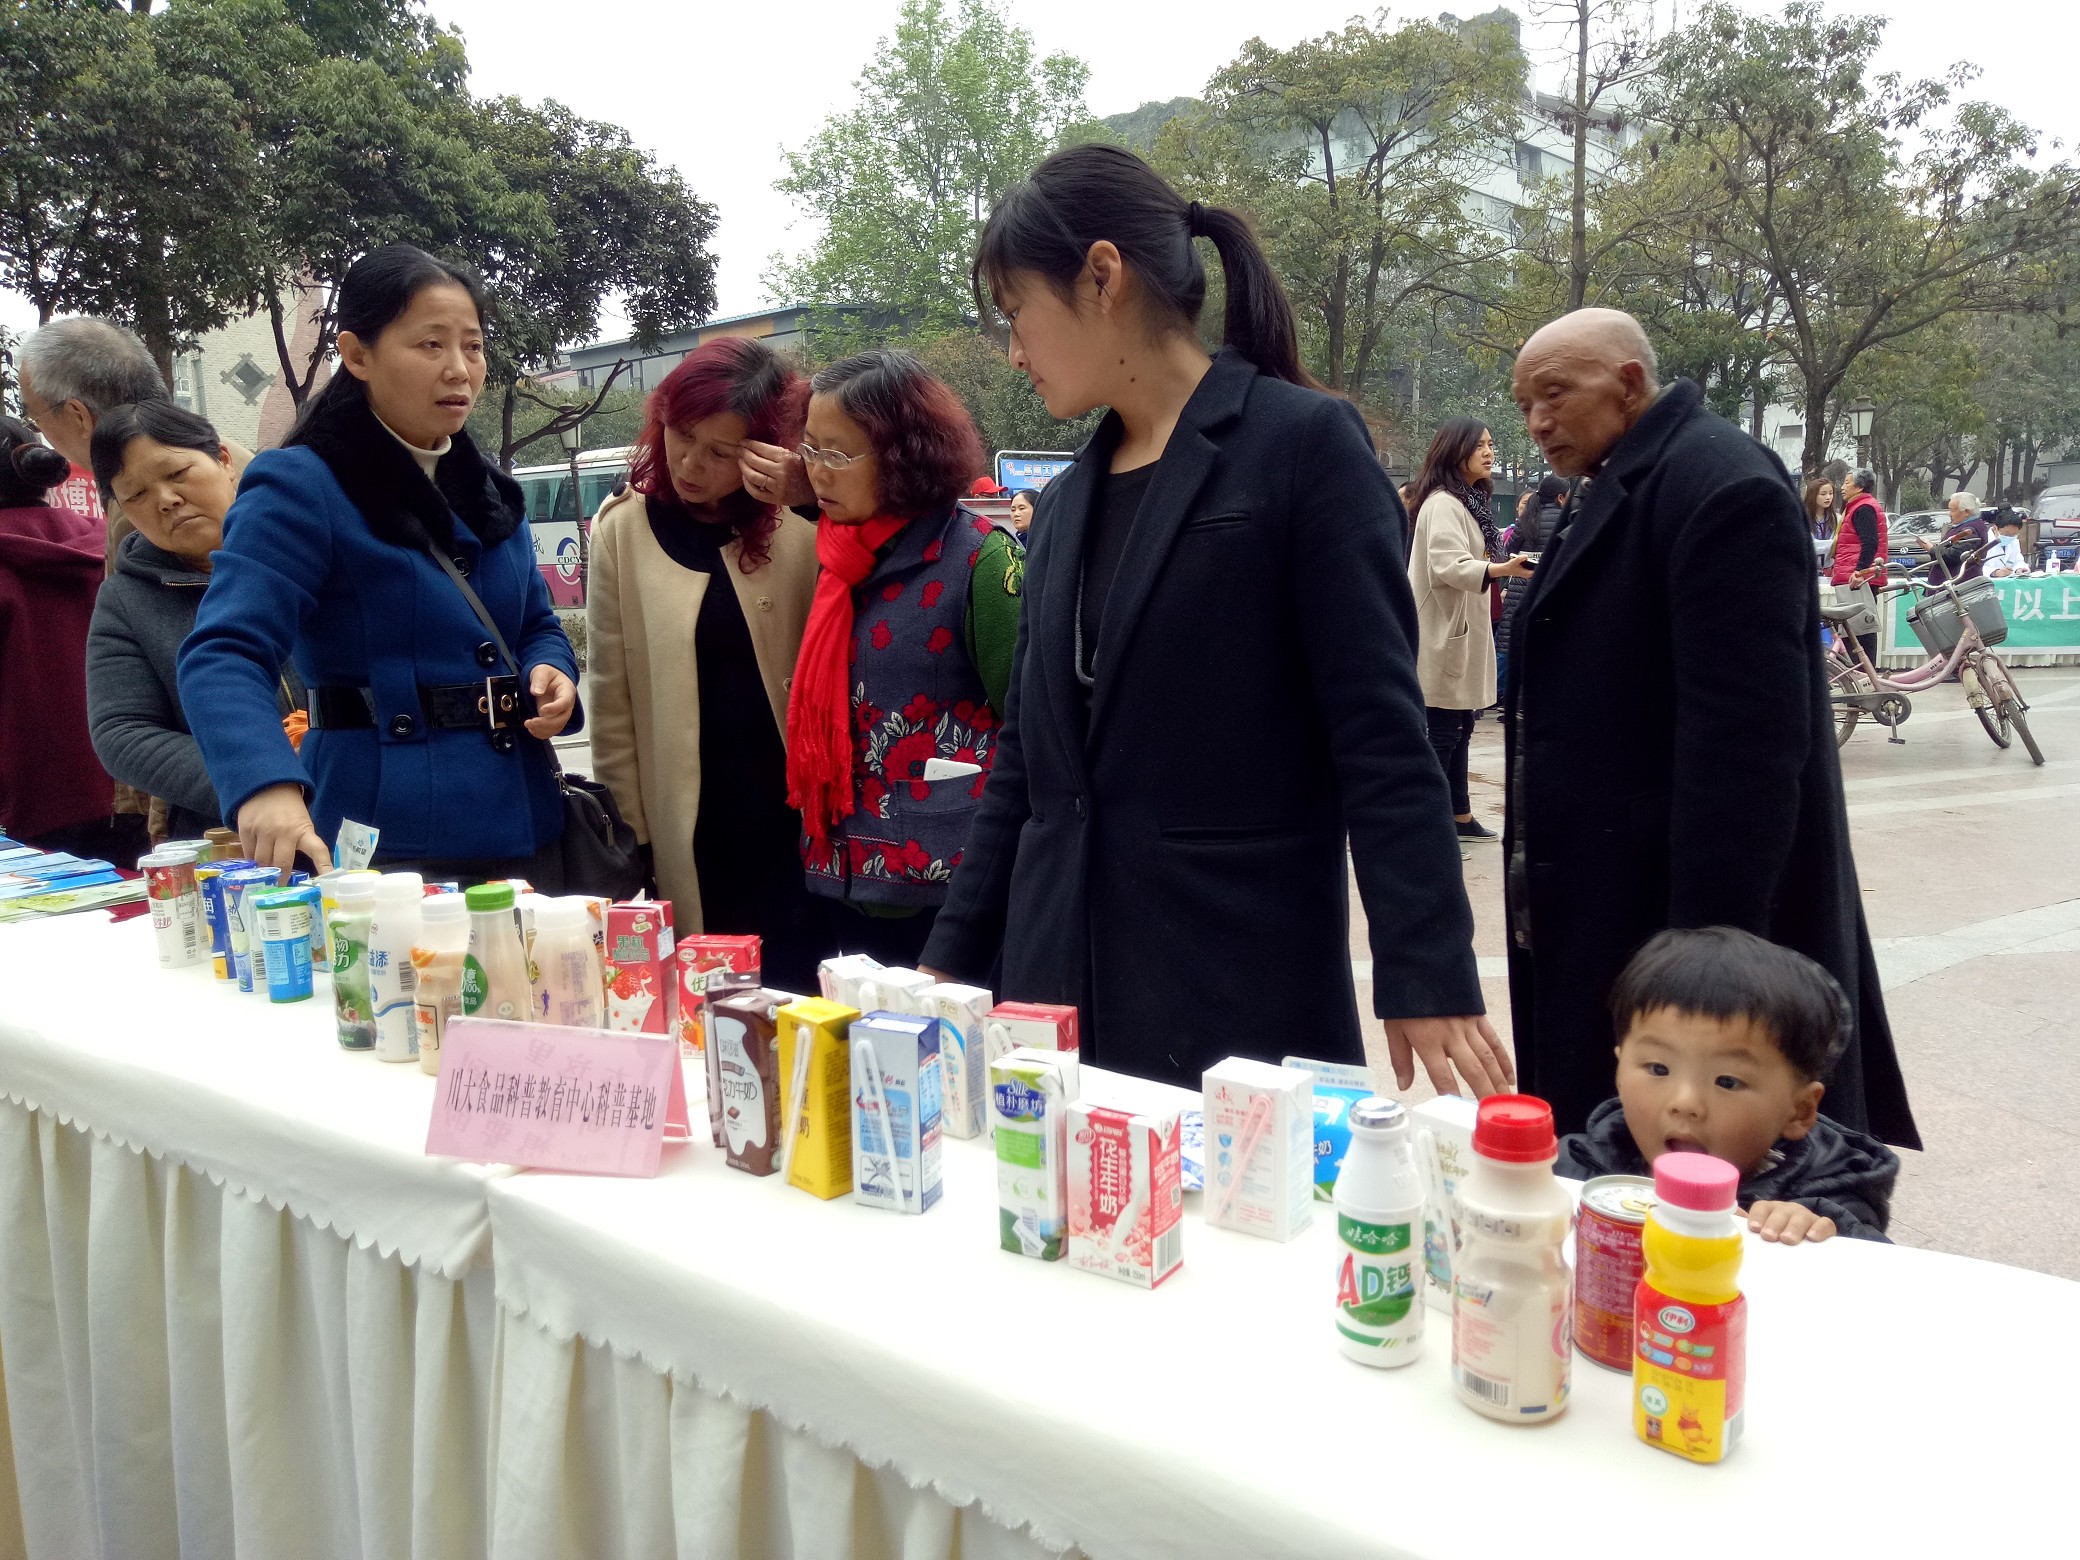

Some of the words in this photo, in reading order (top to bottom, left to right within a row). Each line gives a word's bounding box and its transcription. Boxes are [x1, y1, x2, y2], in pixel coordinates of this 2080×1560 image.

[446, 1068, 657, 1130] 川大食品科普教育中心科普基地
[995, 1092, 1043, 1112] 植朴磨坊
[1007, 1080, 1029, 1096] Silk
[1099, 1136, 1119, 1217] 花生牛奶
[1345, 1225, 1399, 1247] 娃哈哈
[1336, 1252, 1412, 1308] AD钙
